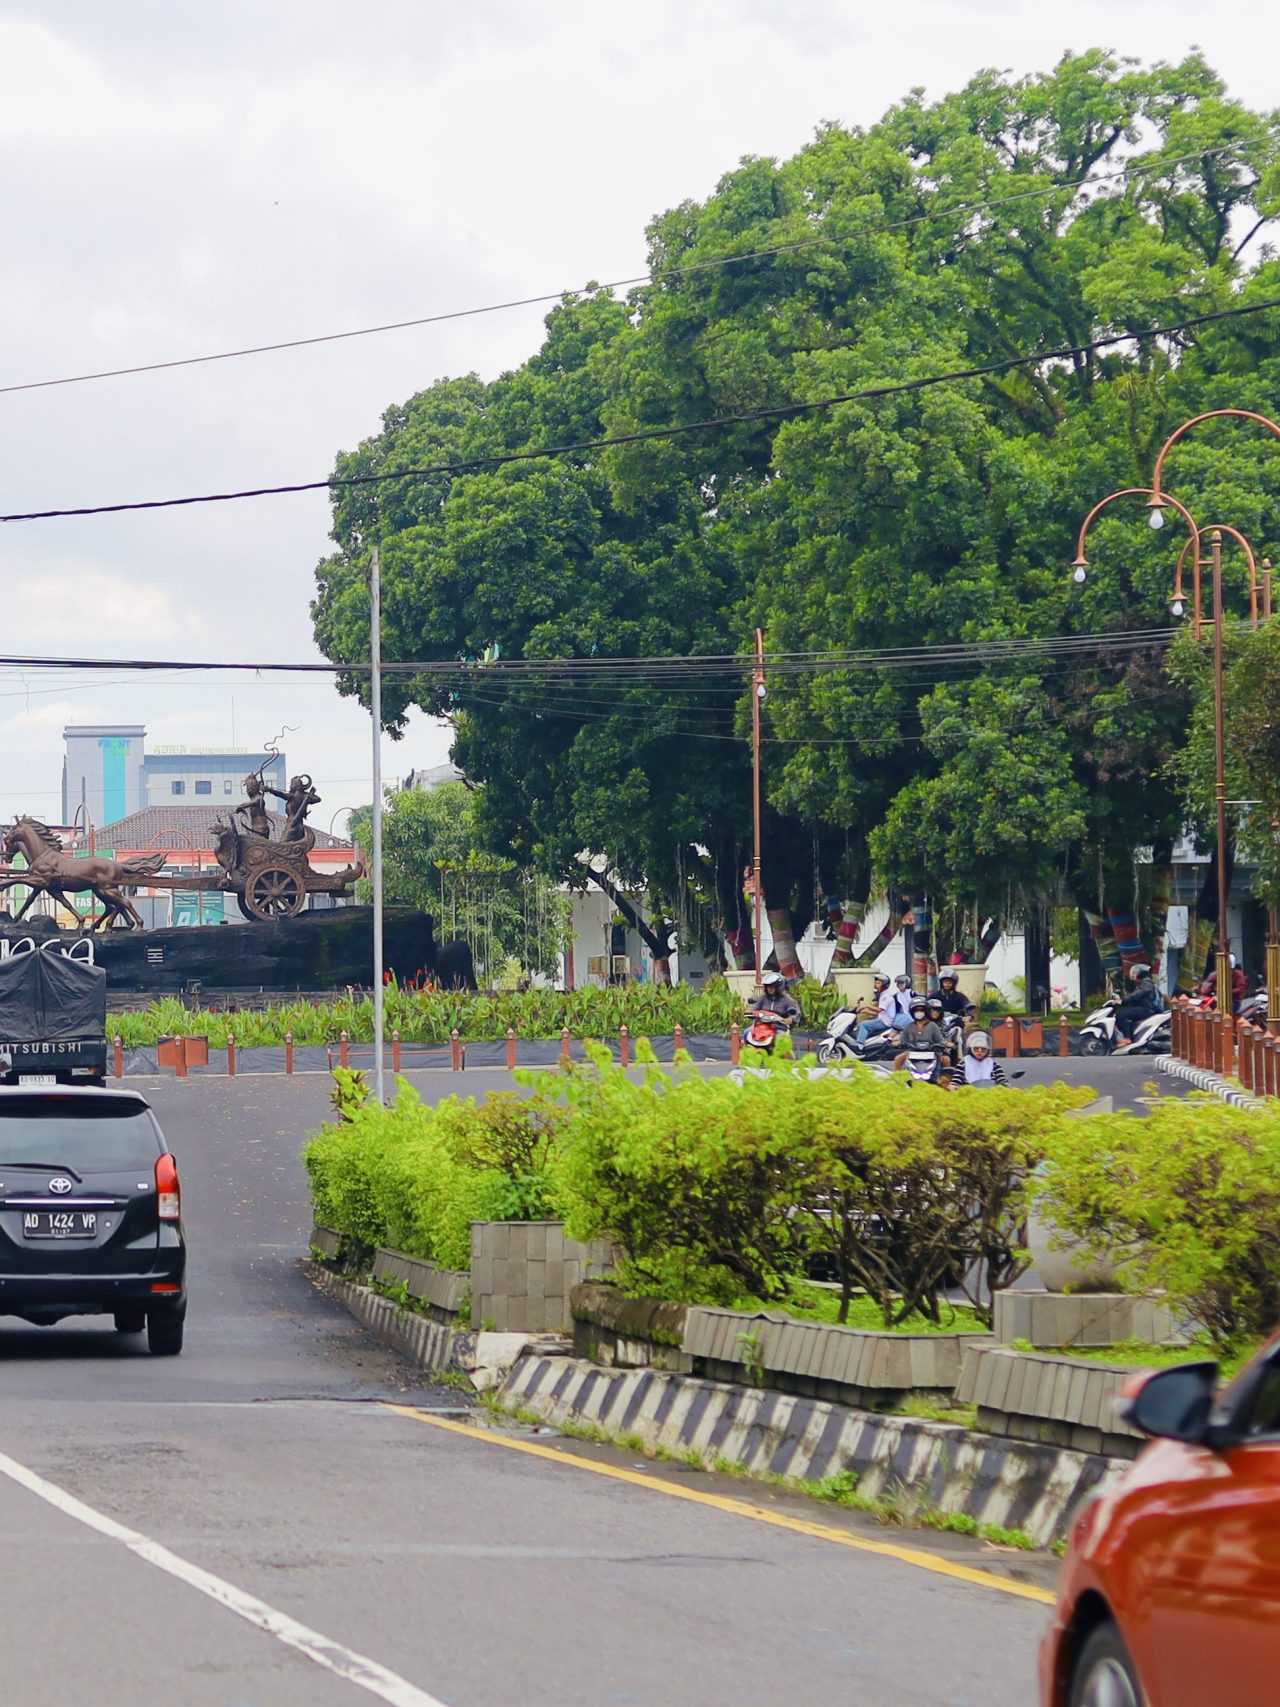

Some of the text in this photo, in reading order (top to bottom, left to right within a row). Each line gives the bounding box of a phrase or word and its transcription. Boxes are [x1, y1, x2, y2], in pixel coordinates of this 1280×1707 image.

[24, 1213, 96, 1228] AD 1424 VP
